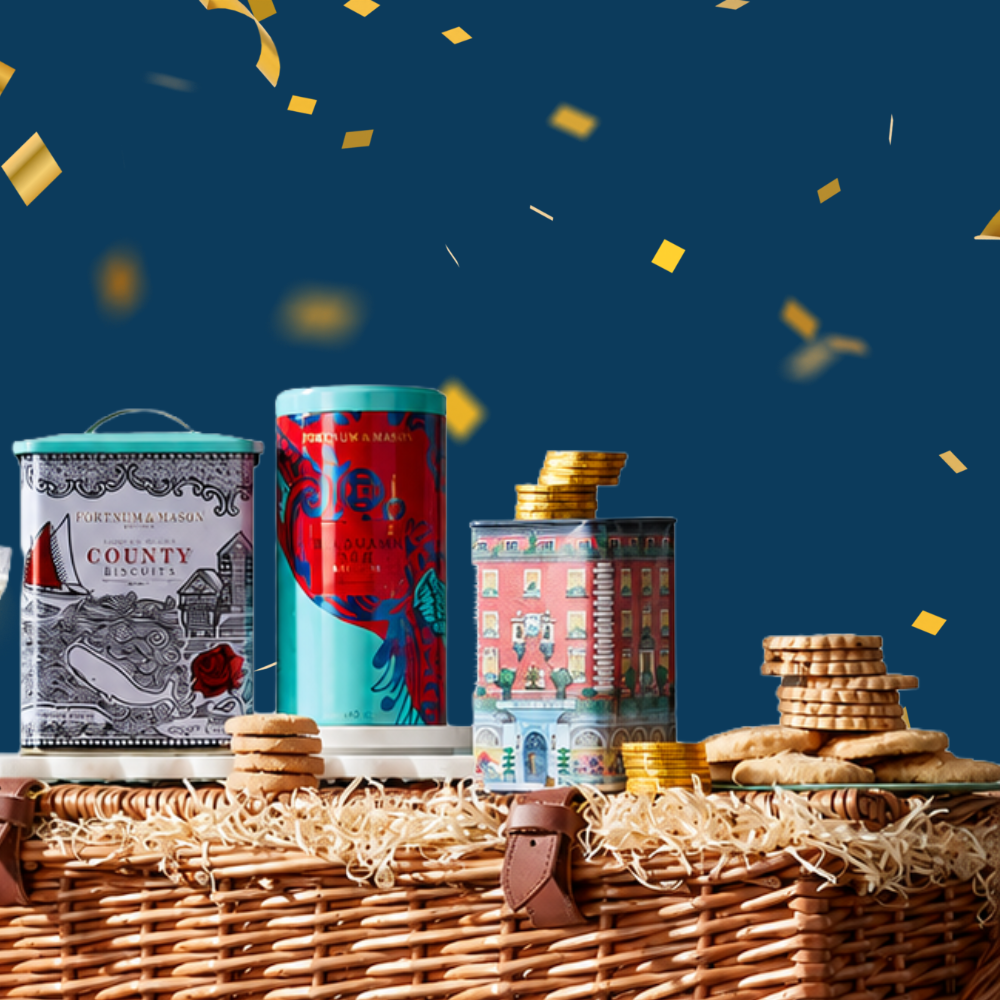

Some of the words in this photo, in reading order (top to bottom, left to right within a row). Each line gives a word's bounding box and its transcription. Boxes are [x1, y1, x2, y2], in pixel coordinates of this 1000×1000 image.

[76, 511, 143, 523] FORTNUM
[158, 511, 204, 523] MASON
[86, 547, 191, 564] COUNTY
[104, 567, 176, 577] BISCUITS
